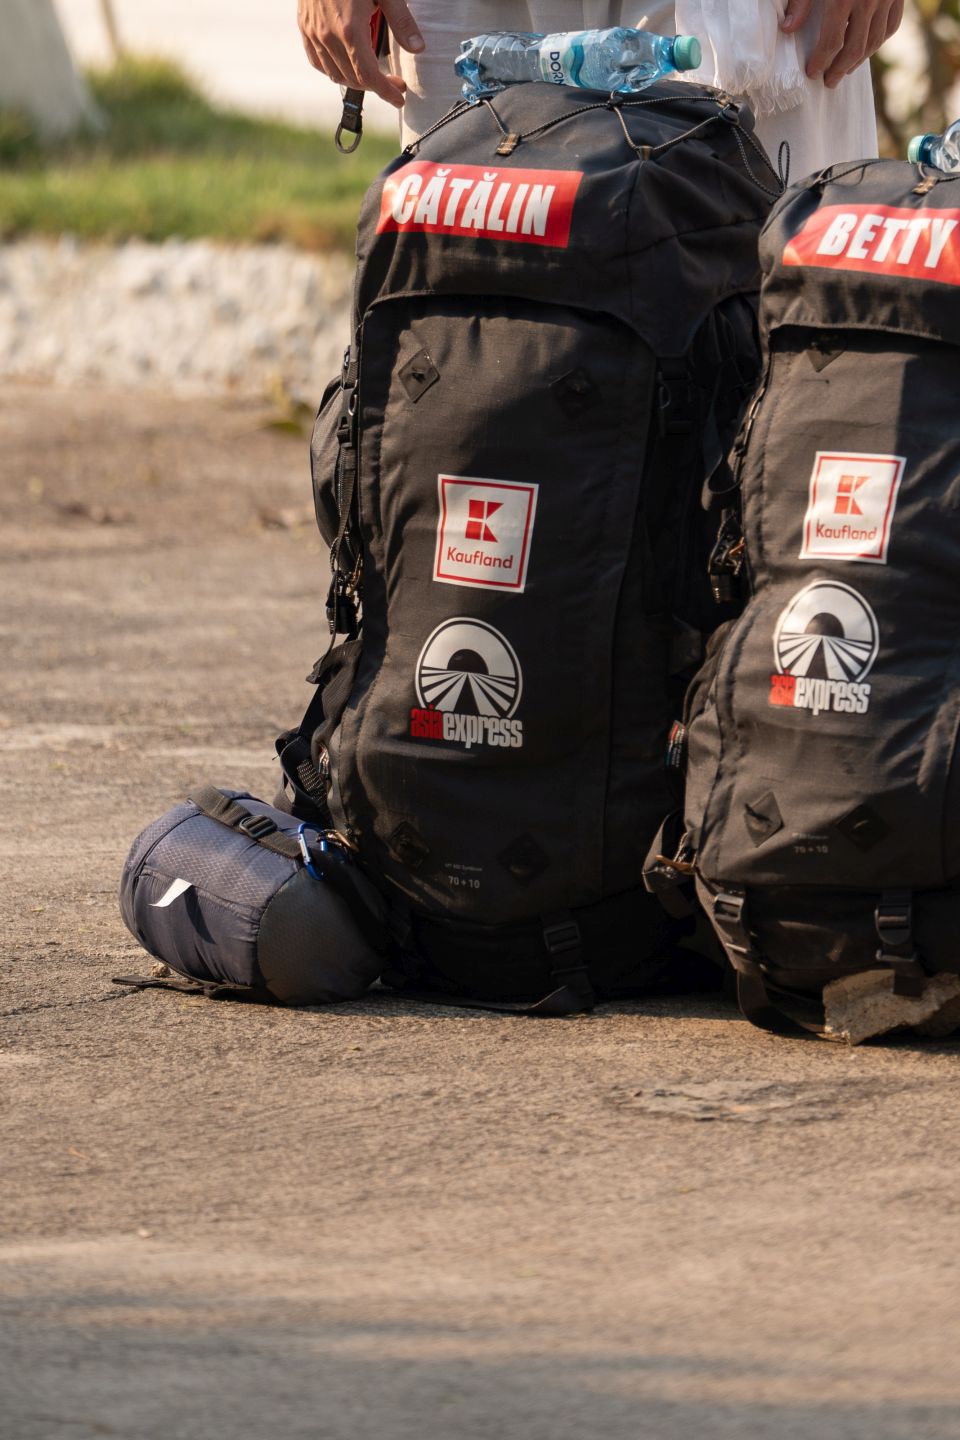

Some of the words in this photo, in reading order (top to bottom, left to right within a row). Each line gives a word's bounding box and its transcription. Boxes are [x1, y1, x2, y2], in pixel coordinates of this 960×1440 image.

[391, 167, 556, 237] CĂTĂLIN
[815, 212, 960, 269] BETTY
[815, 519, 878, 541] Kaufland
[446, 546, 515, 569] Kaufland
